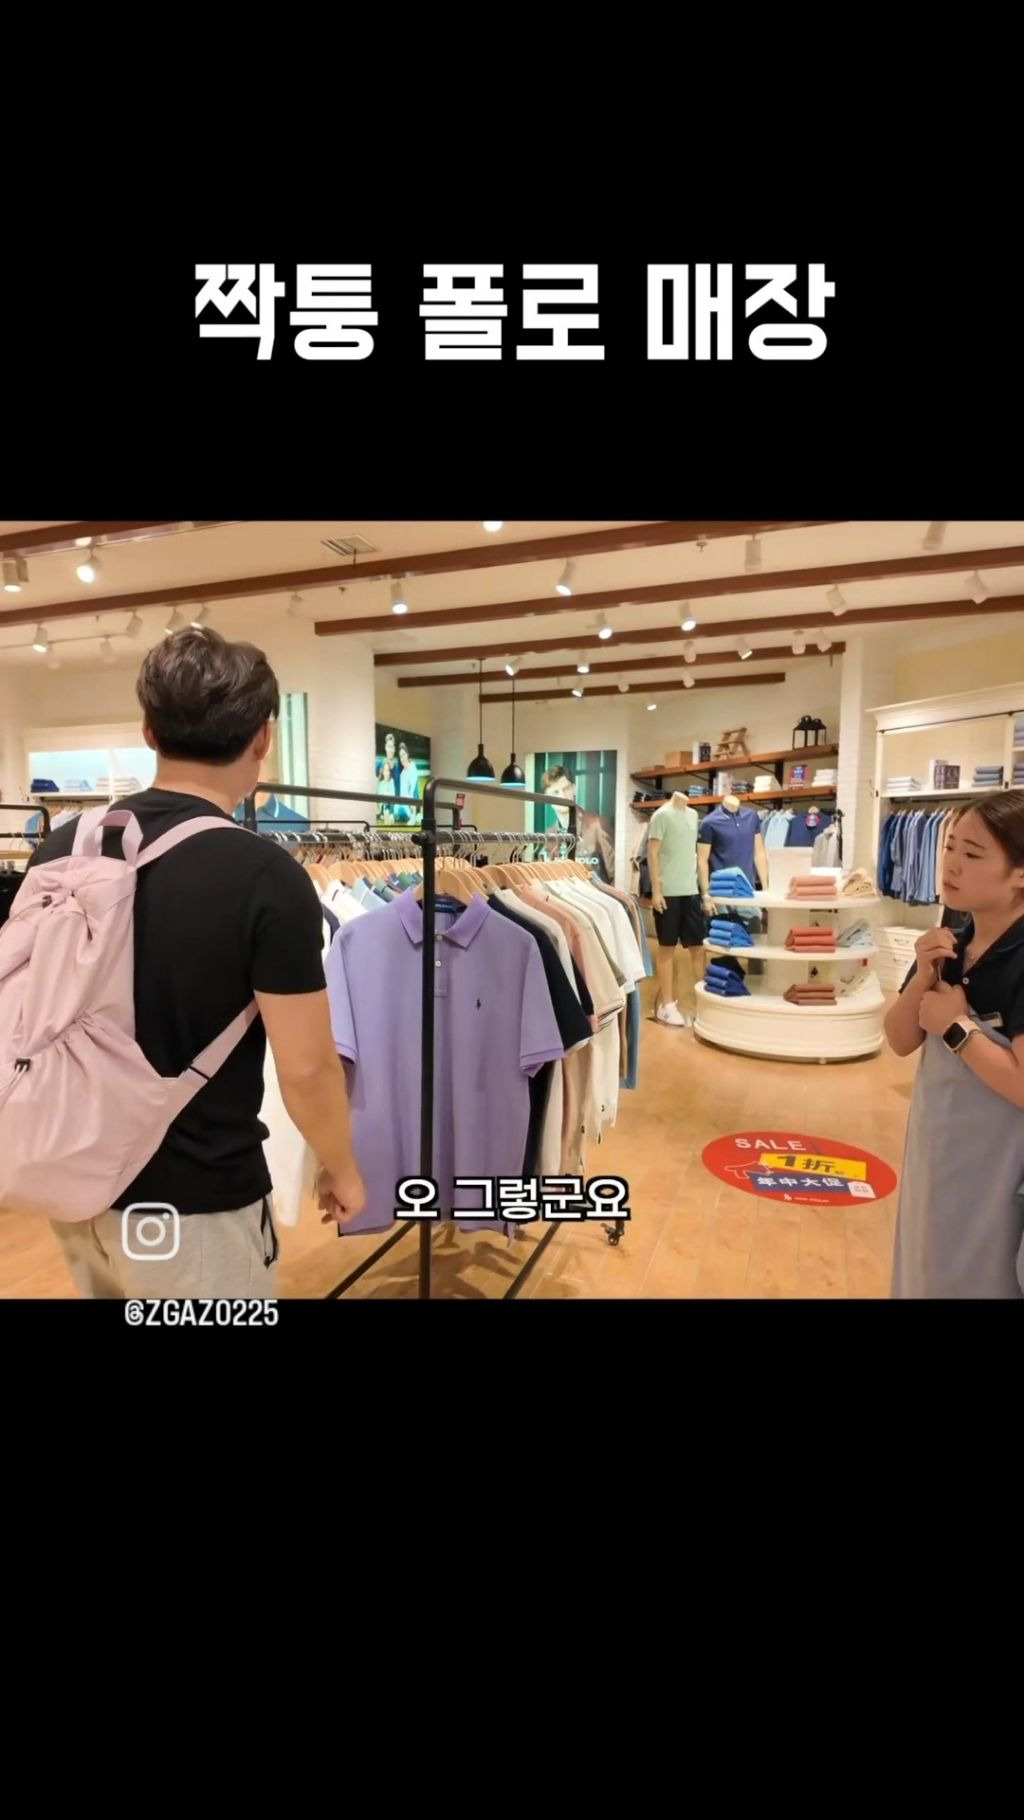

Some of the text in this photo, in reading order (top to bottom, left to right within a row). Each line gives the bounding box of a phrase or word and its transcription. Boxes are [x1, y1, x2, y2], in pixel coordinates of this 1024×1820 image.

[735, 1138, 807, 1151] SALE
[757, 1176, 844, 1188] 年中大促
